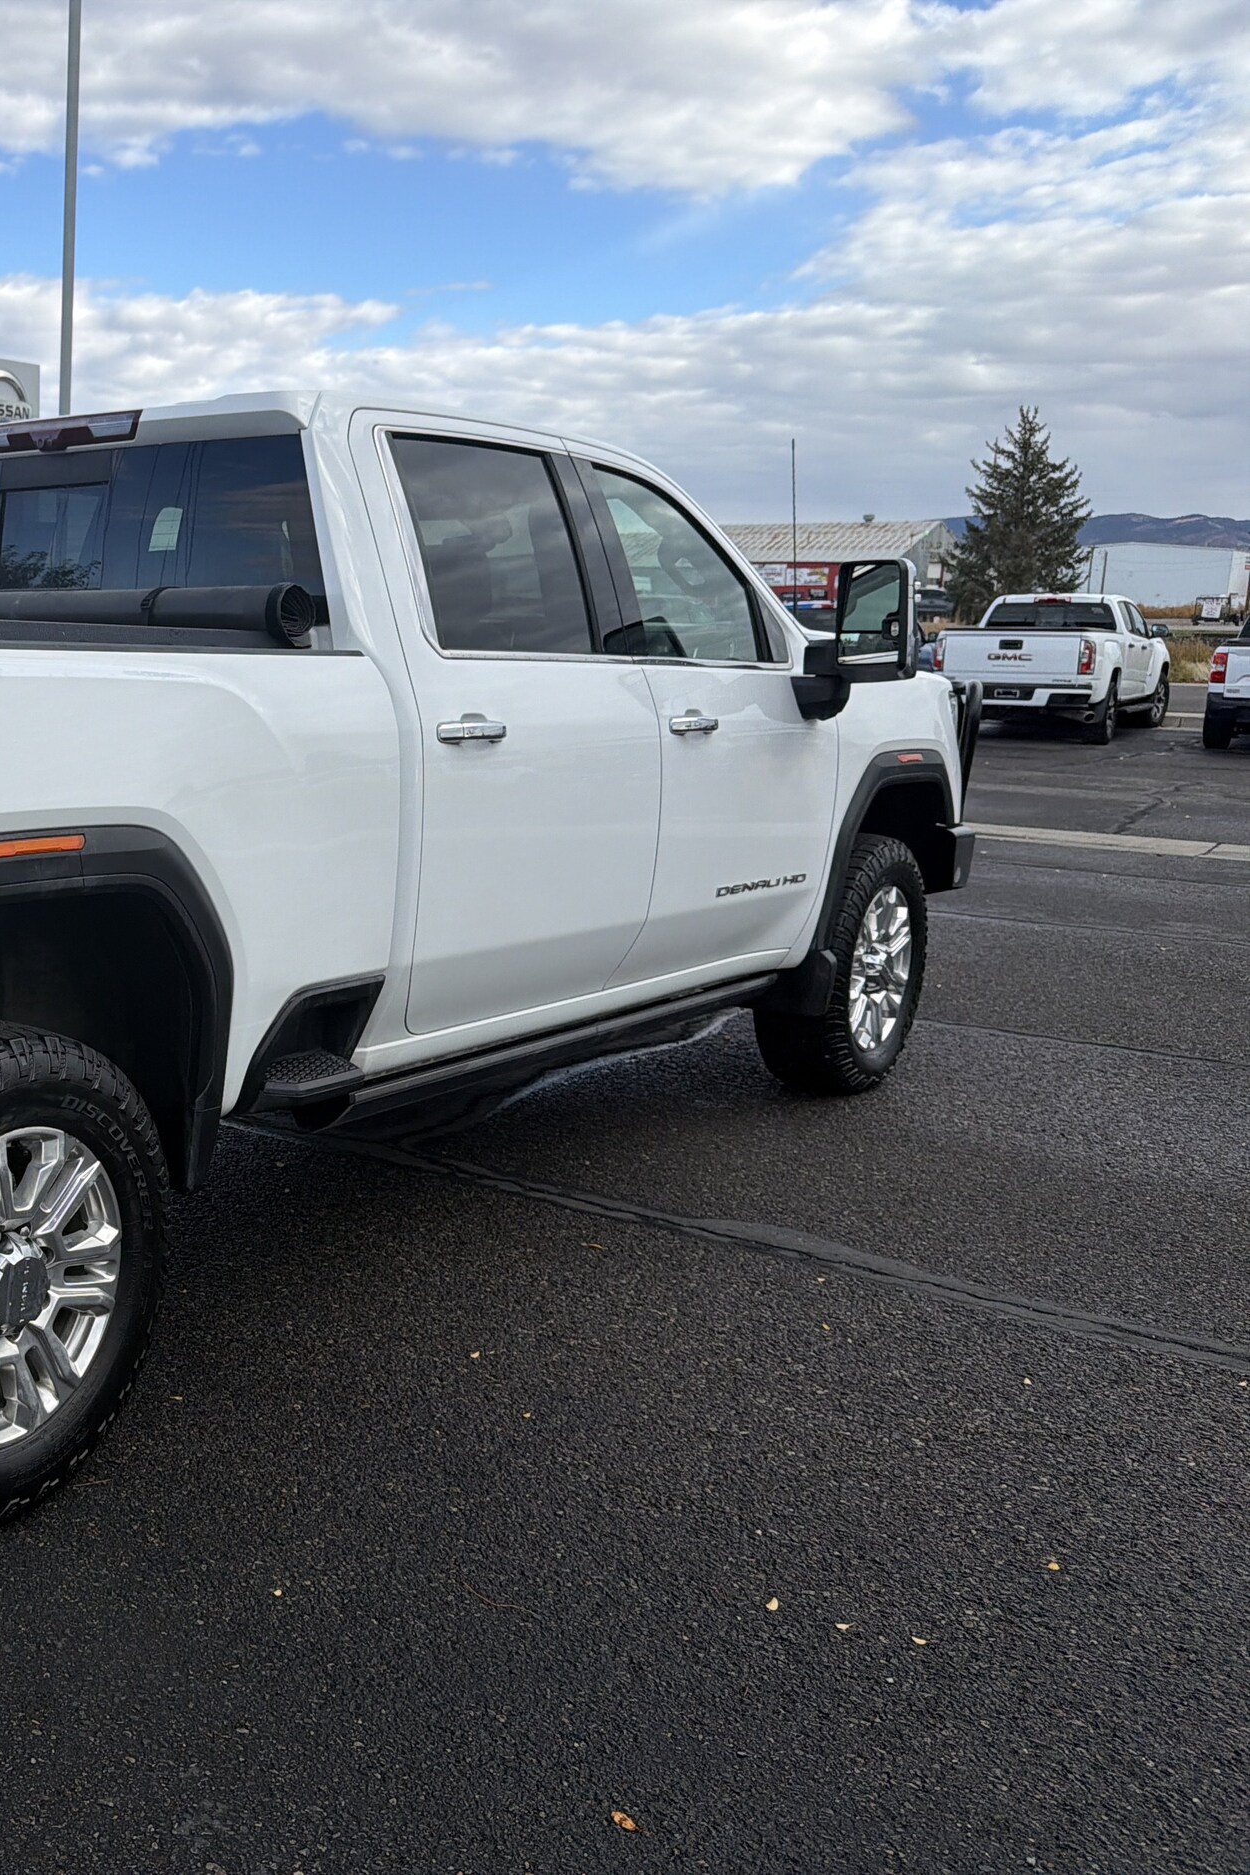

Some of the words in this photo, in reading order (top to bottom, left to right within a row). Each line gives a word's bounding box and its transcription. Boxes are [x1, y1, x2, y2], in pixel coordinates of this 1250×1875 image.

[987, 653, 1033, 662] GMC
[715, 877, 781, 898] DENALI
[782, 873, 807, 887] HD
[61, 1094, 154, 1231] DISCOVERER
